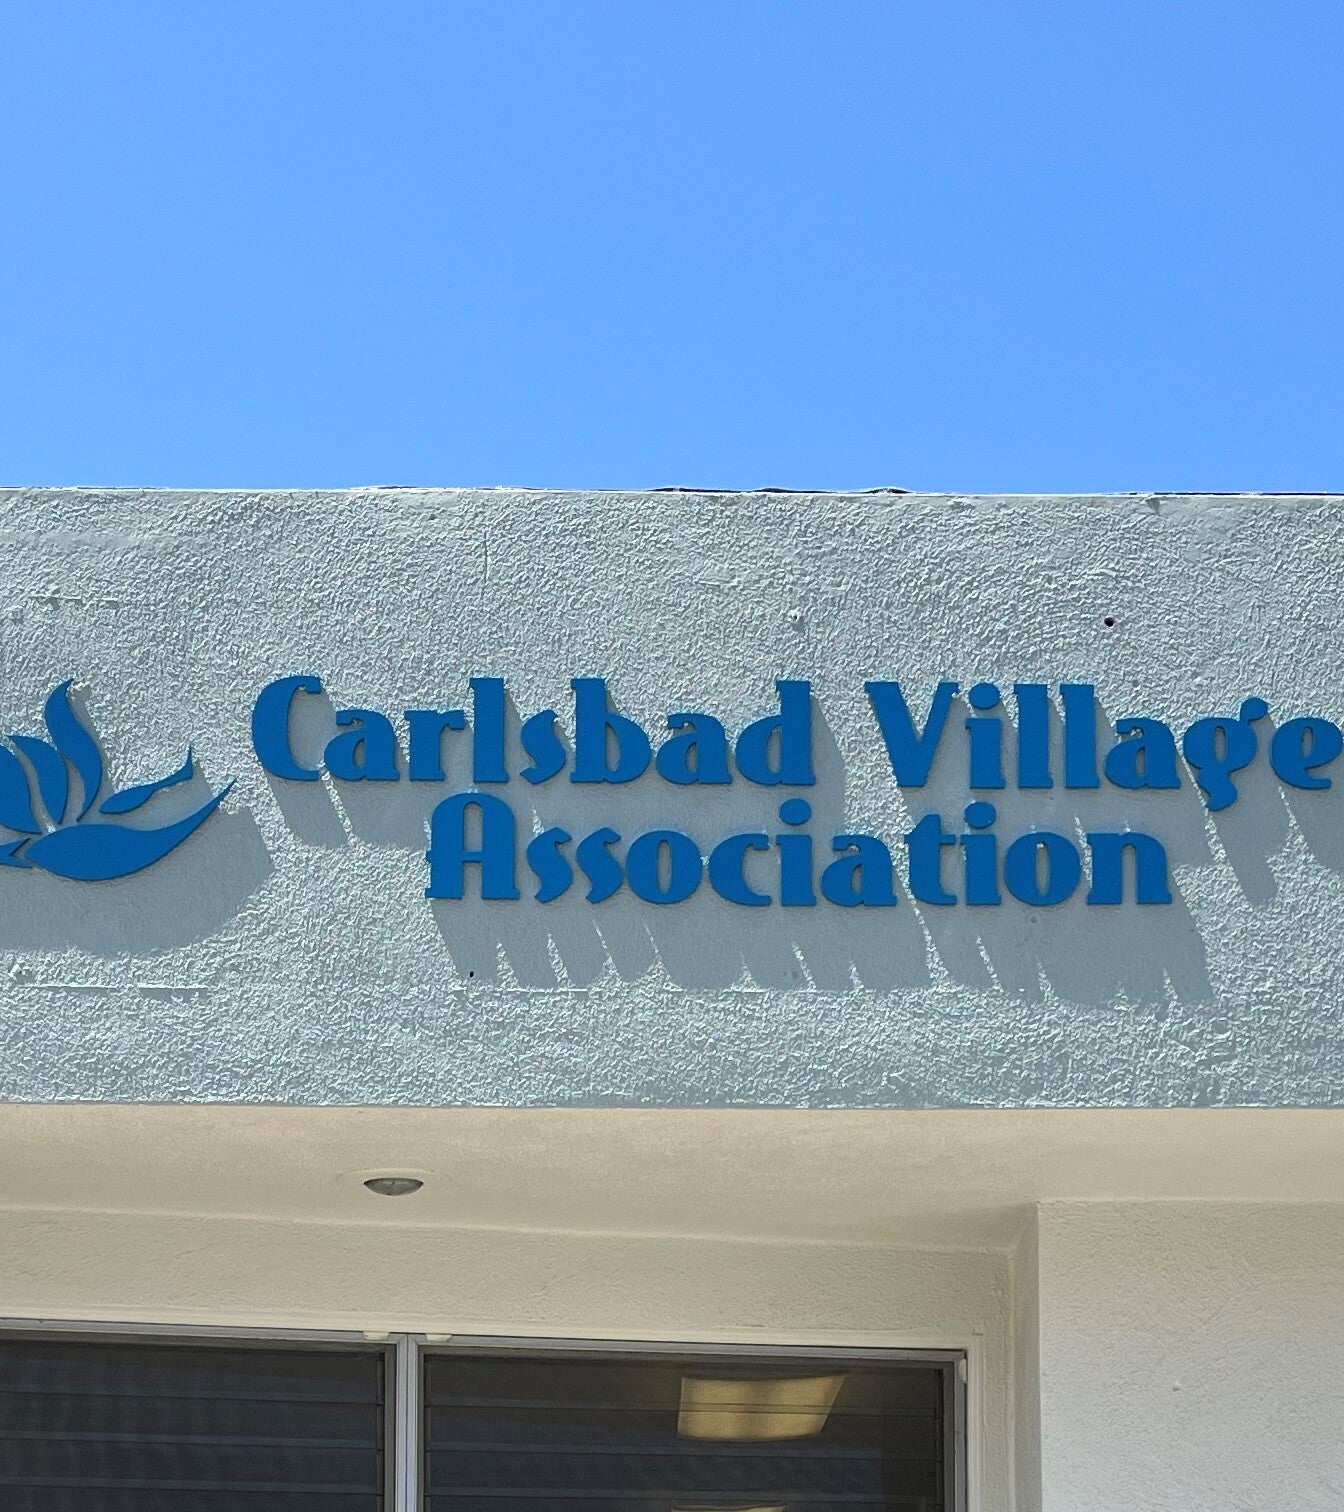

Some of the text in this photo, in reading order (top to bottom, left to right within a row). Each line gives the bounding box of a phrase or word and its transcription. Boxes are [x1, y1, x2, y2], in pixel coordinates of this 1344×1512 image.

[254, 674, 1344, 811] Carlsbad Village
[425, 792, 1172, 907] Association
